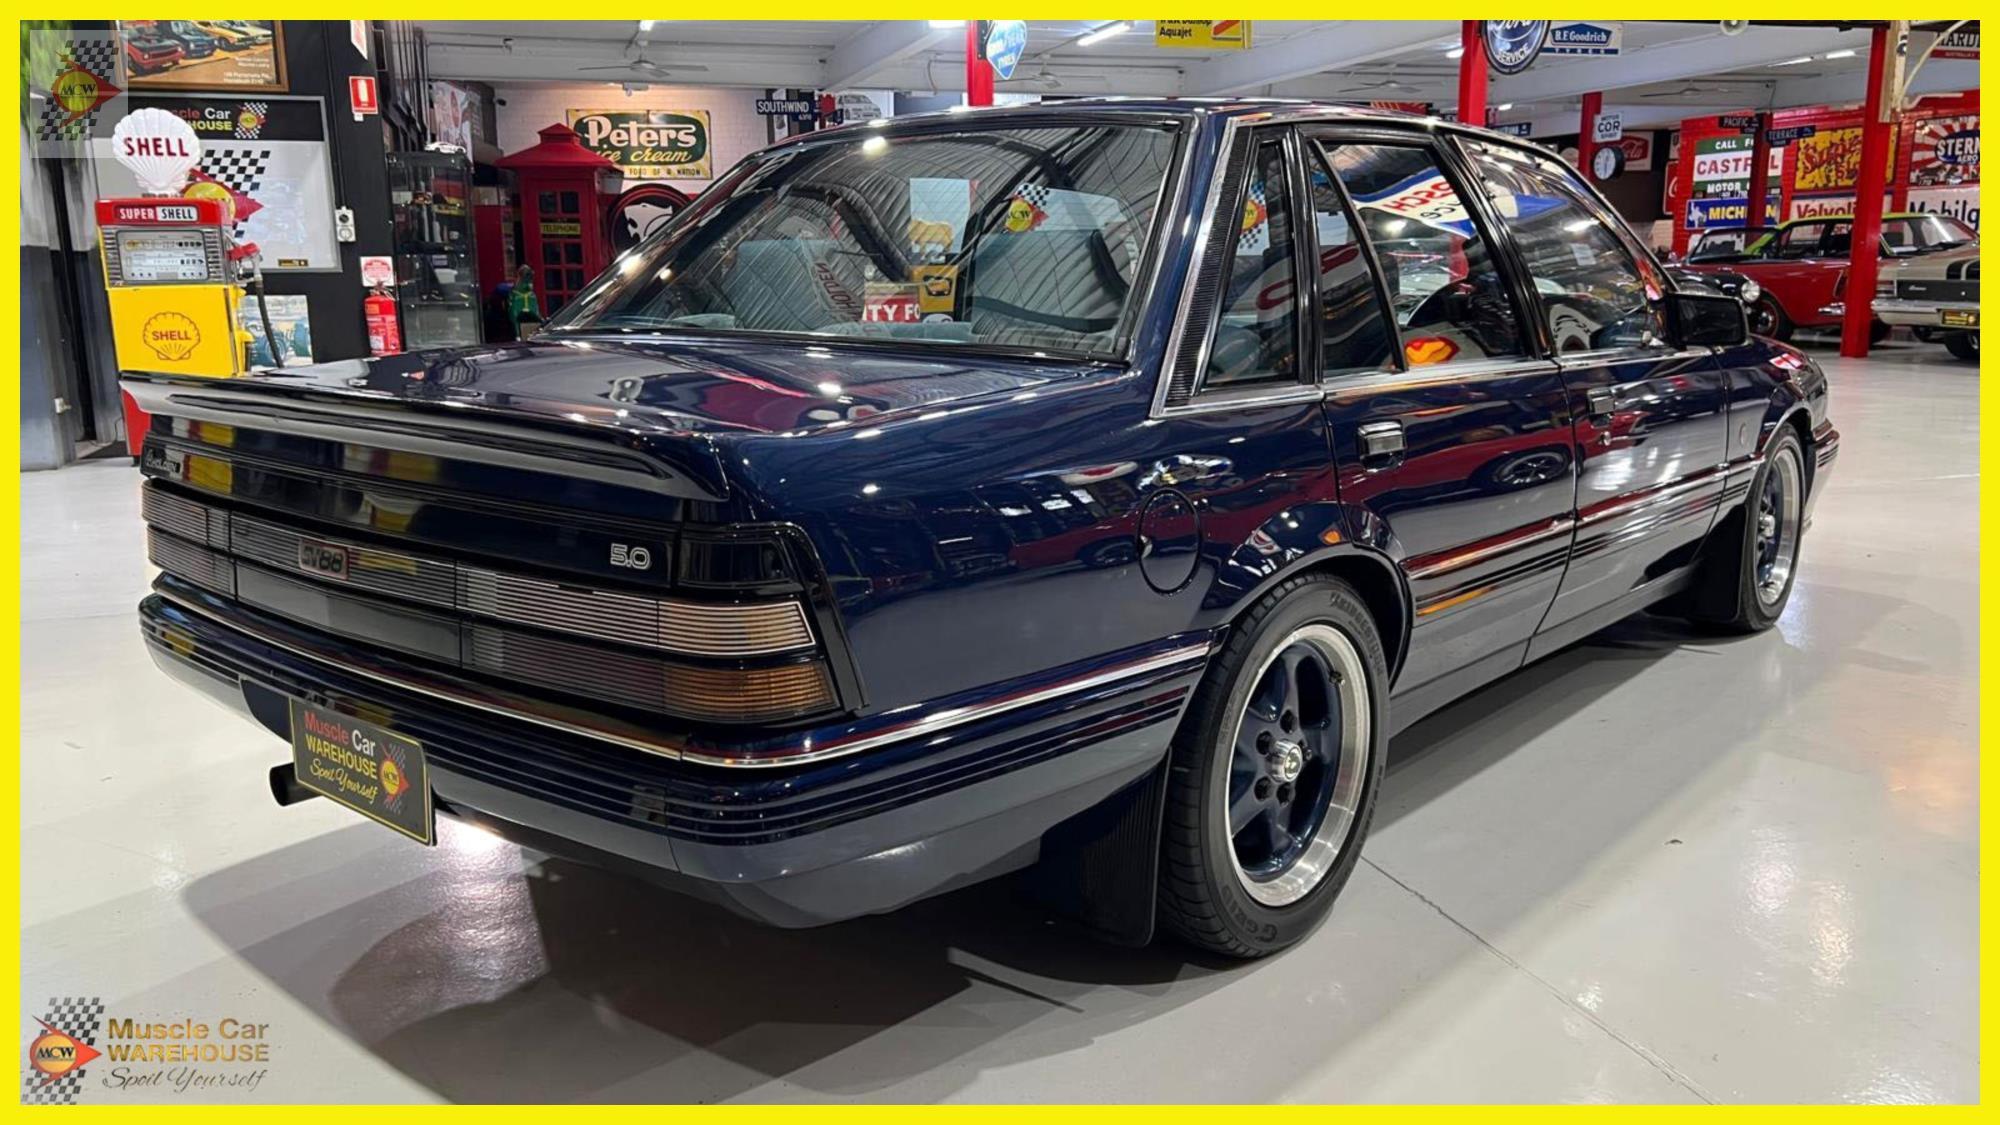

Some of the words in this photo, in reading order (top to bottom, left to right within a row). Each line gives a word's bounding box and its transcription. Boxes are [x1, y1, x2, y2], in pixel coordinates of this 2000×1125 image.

[1159, 26, 1193, 39] Aquajet
[204, 107, 231, 120] Car
[757, 101, 810, 113] SOUTHWIND
[188, 119, 232, 131] HOUSE
[1598, 120, 1621, 133] COR
[1723, 117, 1748, 127] PACIFIC
[582, 116, 697, 149] Peters
[1769, 129, 1798, 140] TERRACE
[123, 137, 190, 157] SHELL
[1715, 138, 1737, 150] CALL
[597, 149, 622, 163] ce
[630, 147, 692, 163] cream
[1697, 154, 1780, 175] CASTRL
[1707, 182, 1741, 194] MOTOR
[119, 207, 157, 220] SUPER
[161, 207, 194, 220] SHELL
[1709, 205, 1777, 220] MICHN
[1796, 202, 1856, 219] Valvoli
[543, 225, 579, 233] TELEPHONE
[151, 330, 192, 341] SHELL
[610, 543, 651, 570] 5.0
[304, 710, 349, 745] Muscle
[351, 729, 376, 757] Car
[305, 735, 378, 780] WAREHOUSE
[335, 767, 379, 805] Yourself
